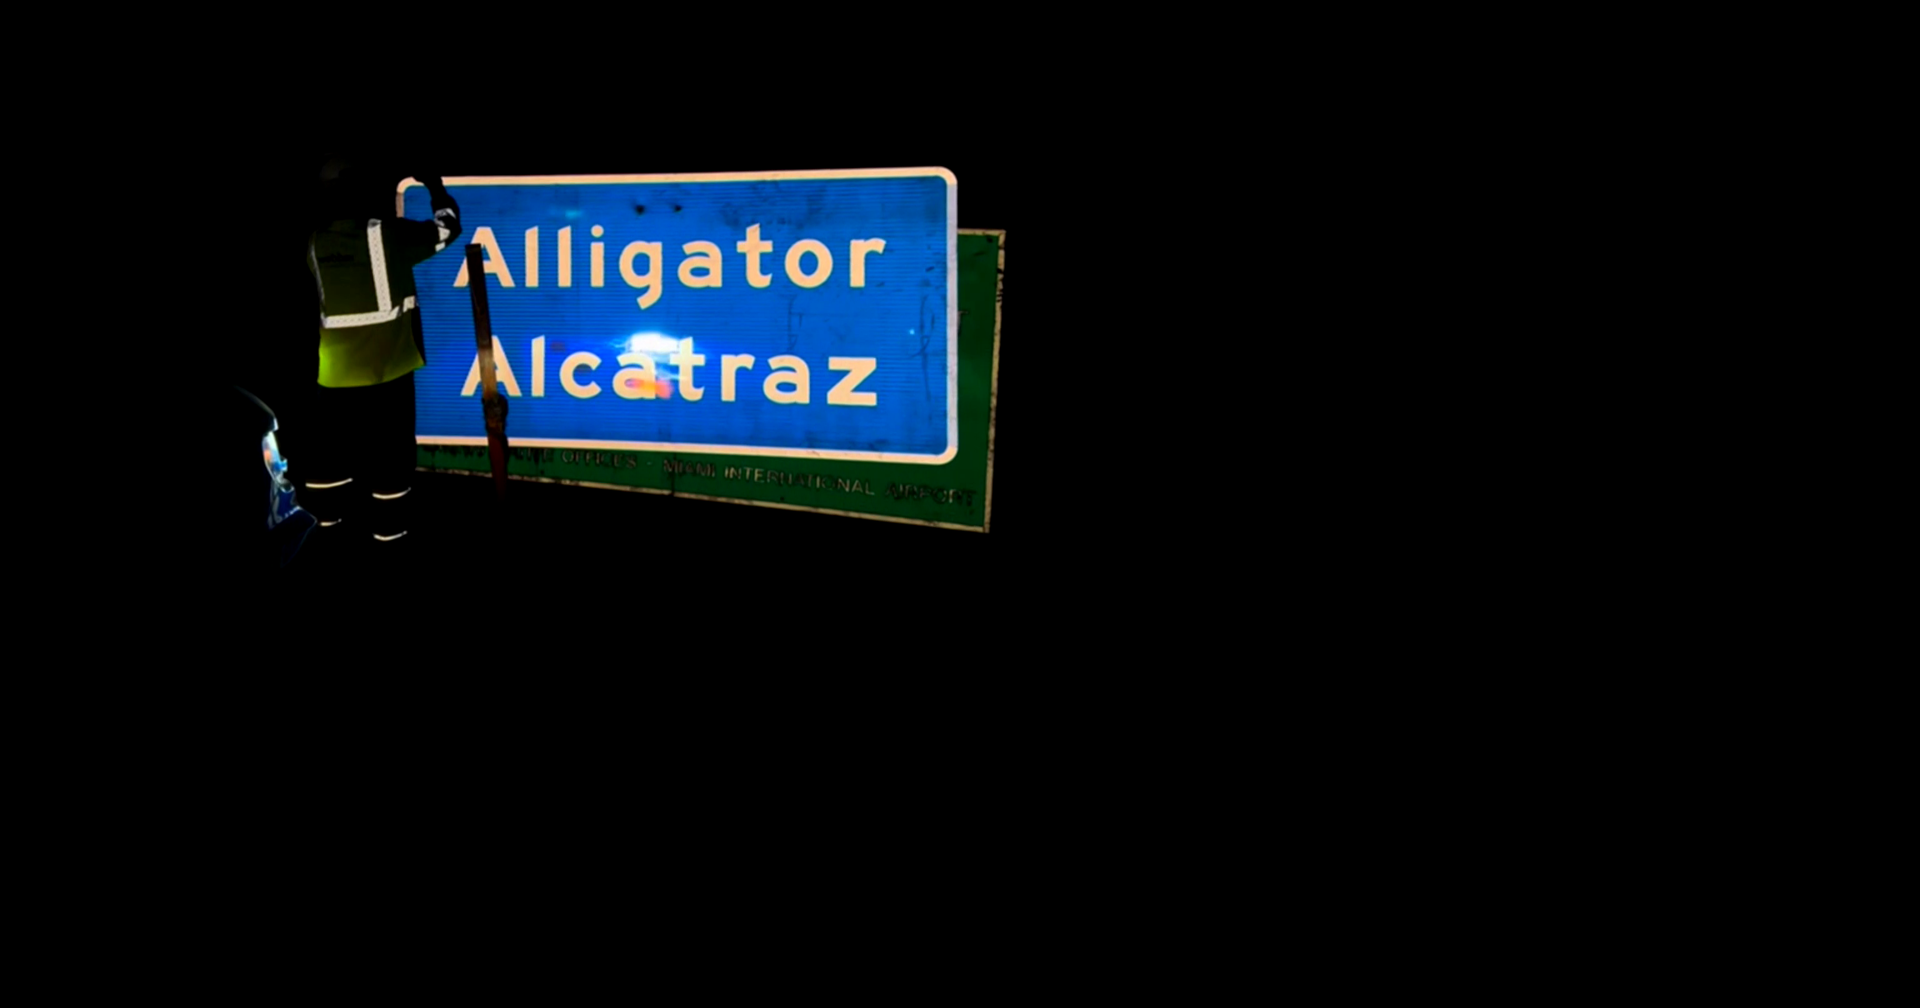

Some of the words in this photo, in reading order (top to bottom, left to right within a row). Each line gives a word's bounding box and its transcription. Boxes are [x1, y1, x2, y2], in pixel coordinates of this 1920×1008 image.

[453, 223, 886, 309] Alligator
[461, 335, 878, 406] Alcatraz
[561, 450, 637, 469] OFFICES
[663, 459, 716, 478] MIAMI
[724, 466, 875, 496] INTERNATIONAL
[884, 482, 977, 507] AIRPORT
